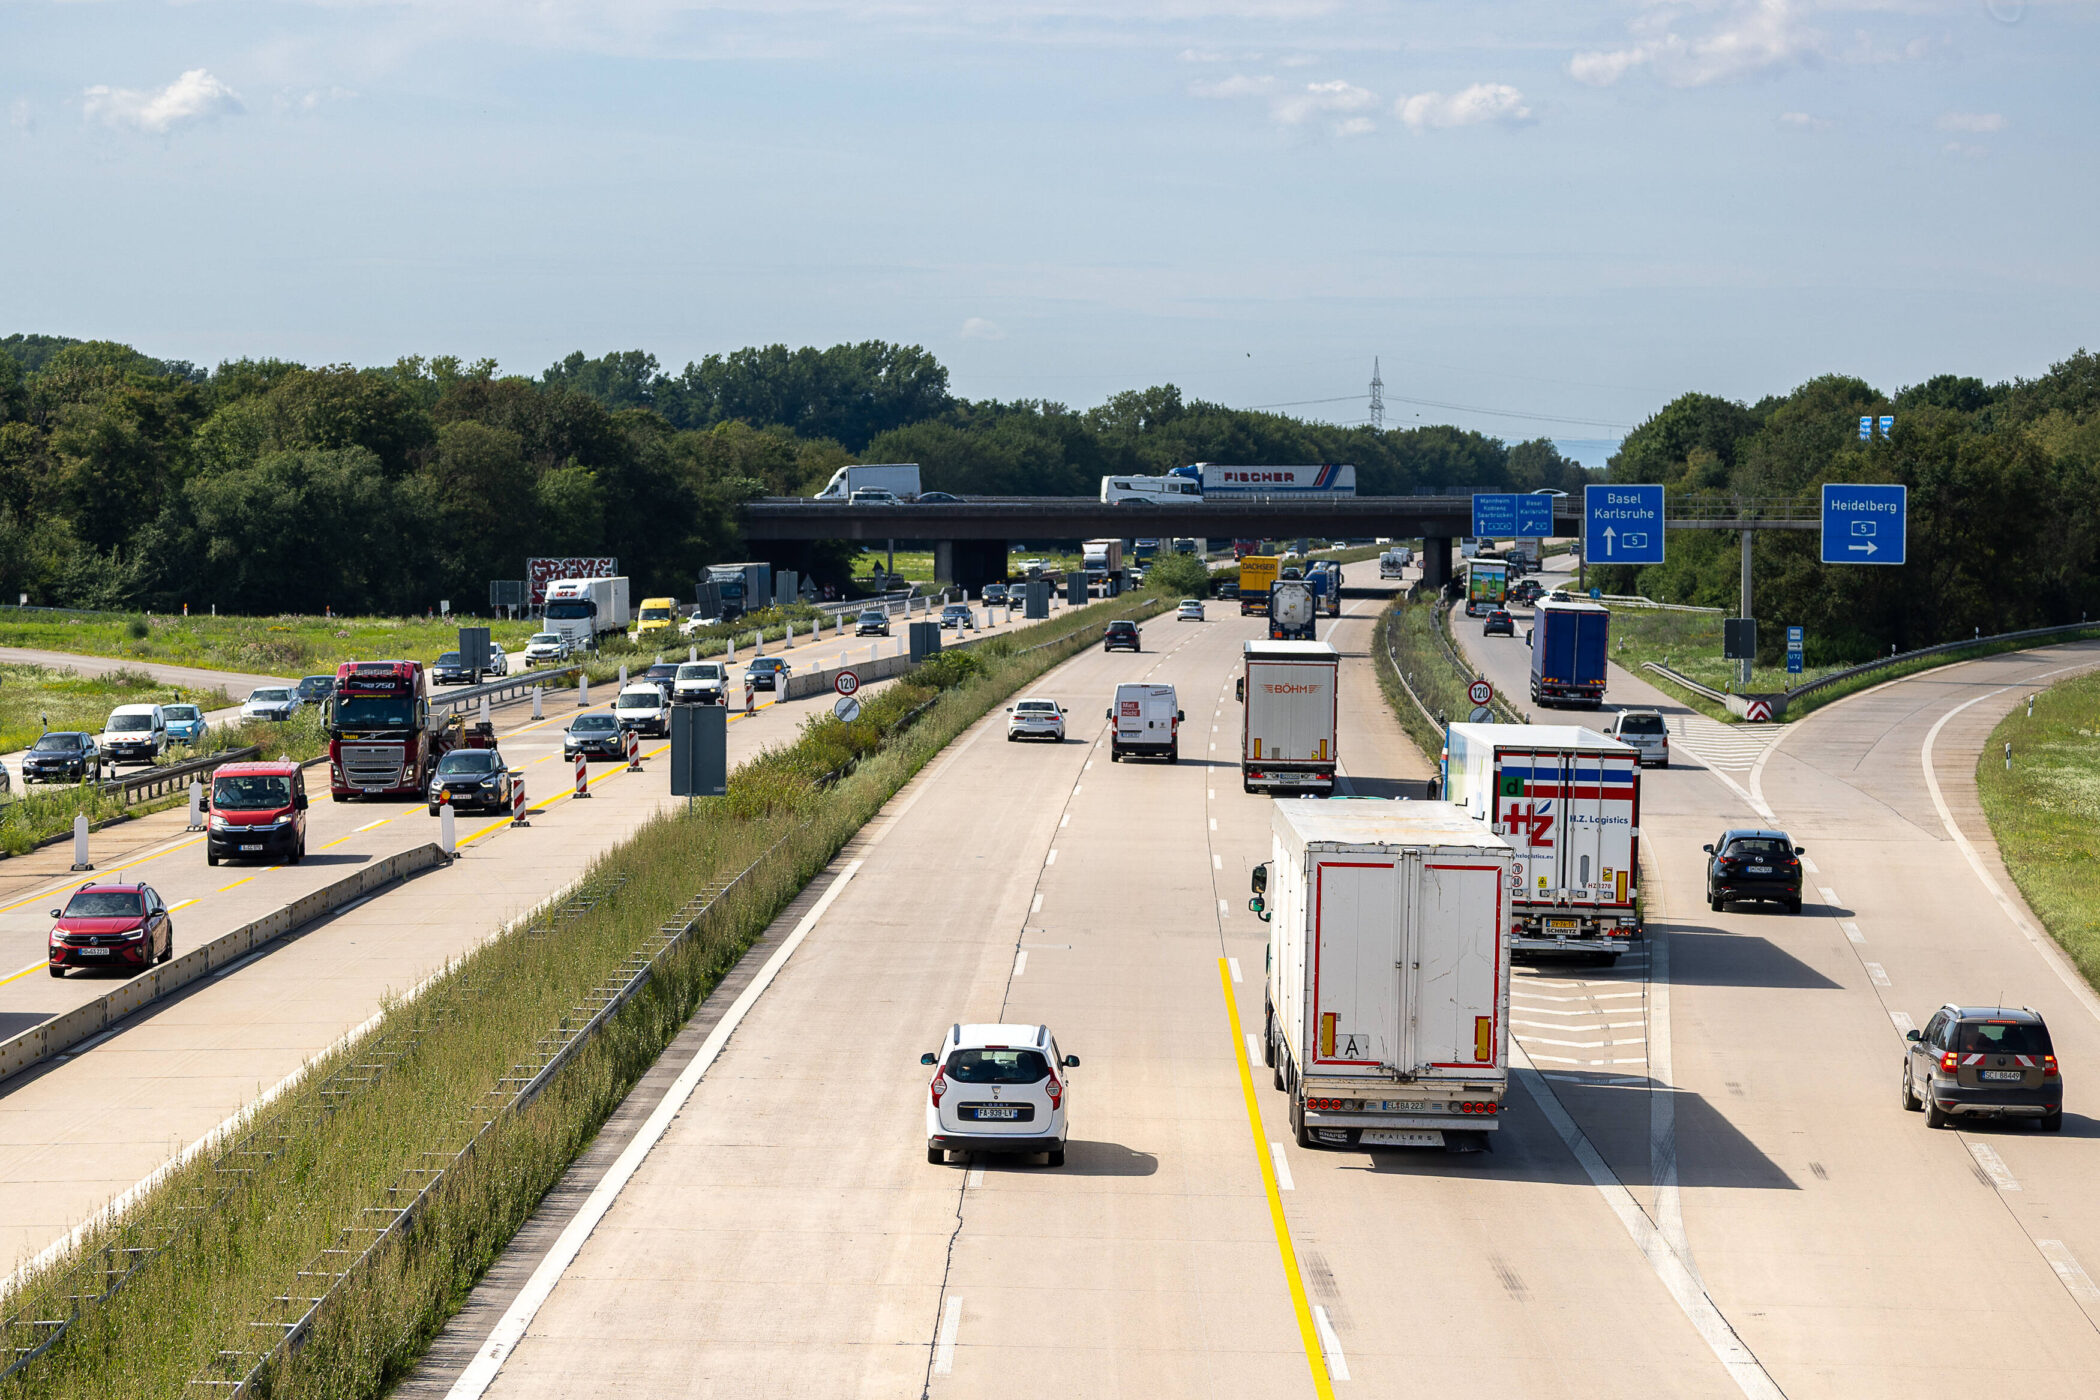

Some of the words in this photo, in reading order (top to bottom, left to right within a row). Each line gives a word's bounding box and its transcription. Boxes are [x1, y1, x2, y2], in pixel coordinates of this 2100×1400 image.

[1224, 471, 1295, 482] FISCHER
[1608, 493, 1641, 504] Basel
[1831, 499, 1897, 514] Heidelberg
[1595, 508, 1655, 519] Karlsruhe
[1860, 524, 1867, 533] 5
[1632, 536, 1638, 545] 5
[1242, 562, 1275, 571] DACHSER
[839, 677, 855, 689] 120
[1274, 683, 1308, 694] BÖHM
[1473, 687, 1488, 699] 120
[1506, 779, 1518, 795] d
[1502, 803, 1554, 847] HZ
[1590, 815, 1629, 825] Logistics
[1345, 1038, 1359, 1056] A
[1999, 1071, 2020, 1079] 88449
[1371, 1133, 1433, 1141] TRAILERS
